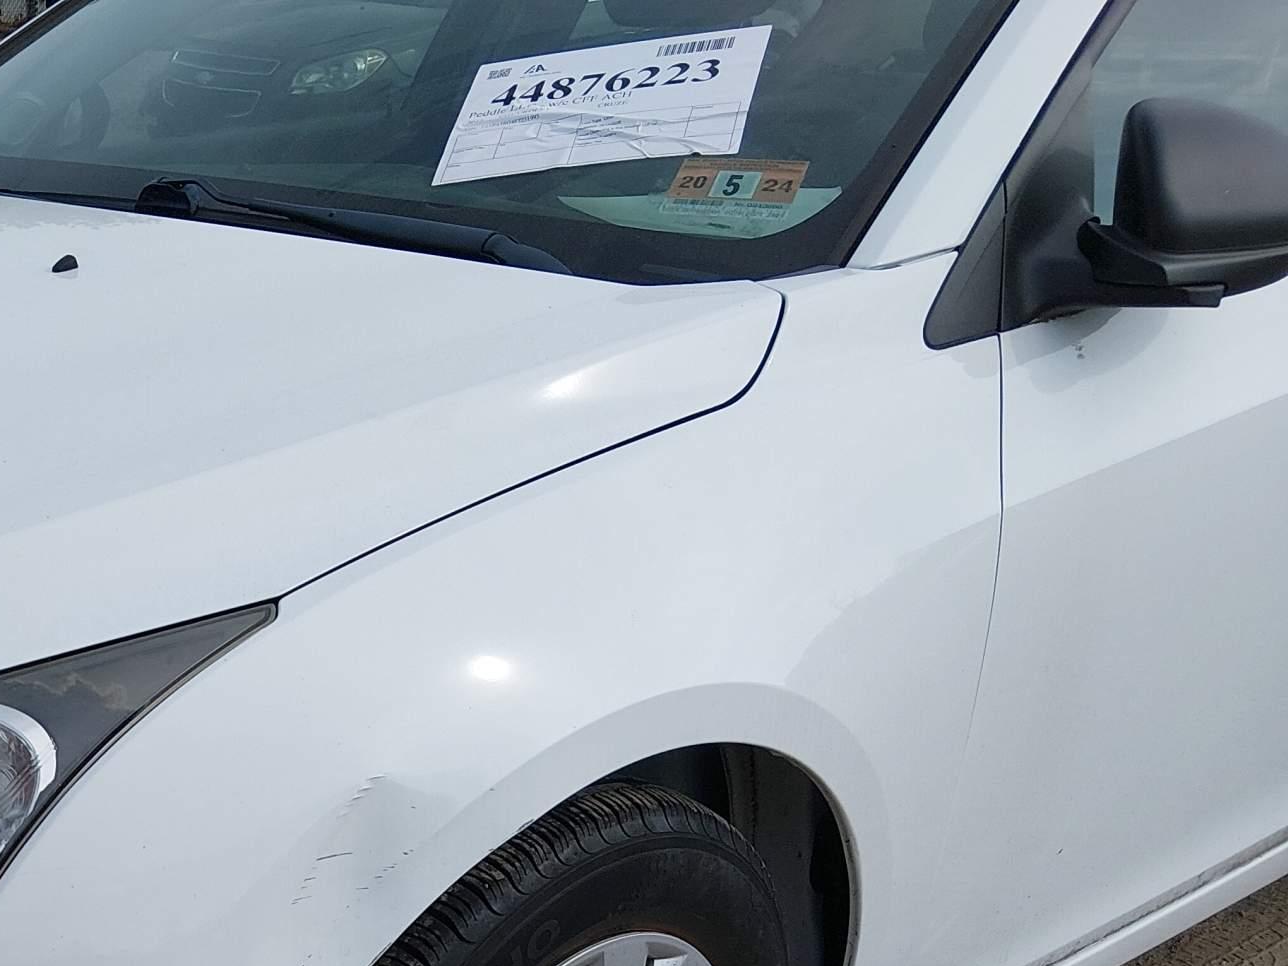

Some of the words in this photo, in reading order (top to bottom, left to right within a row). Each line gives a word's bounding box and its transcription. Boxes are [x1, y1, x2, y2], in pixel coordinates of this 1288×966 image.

[492, 58, 721, 107] 44876223
[679, 175, 707, 189] 20
[722, 174, 744, 196] 5
